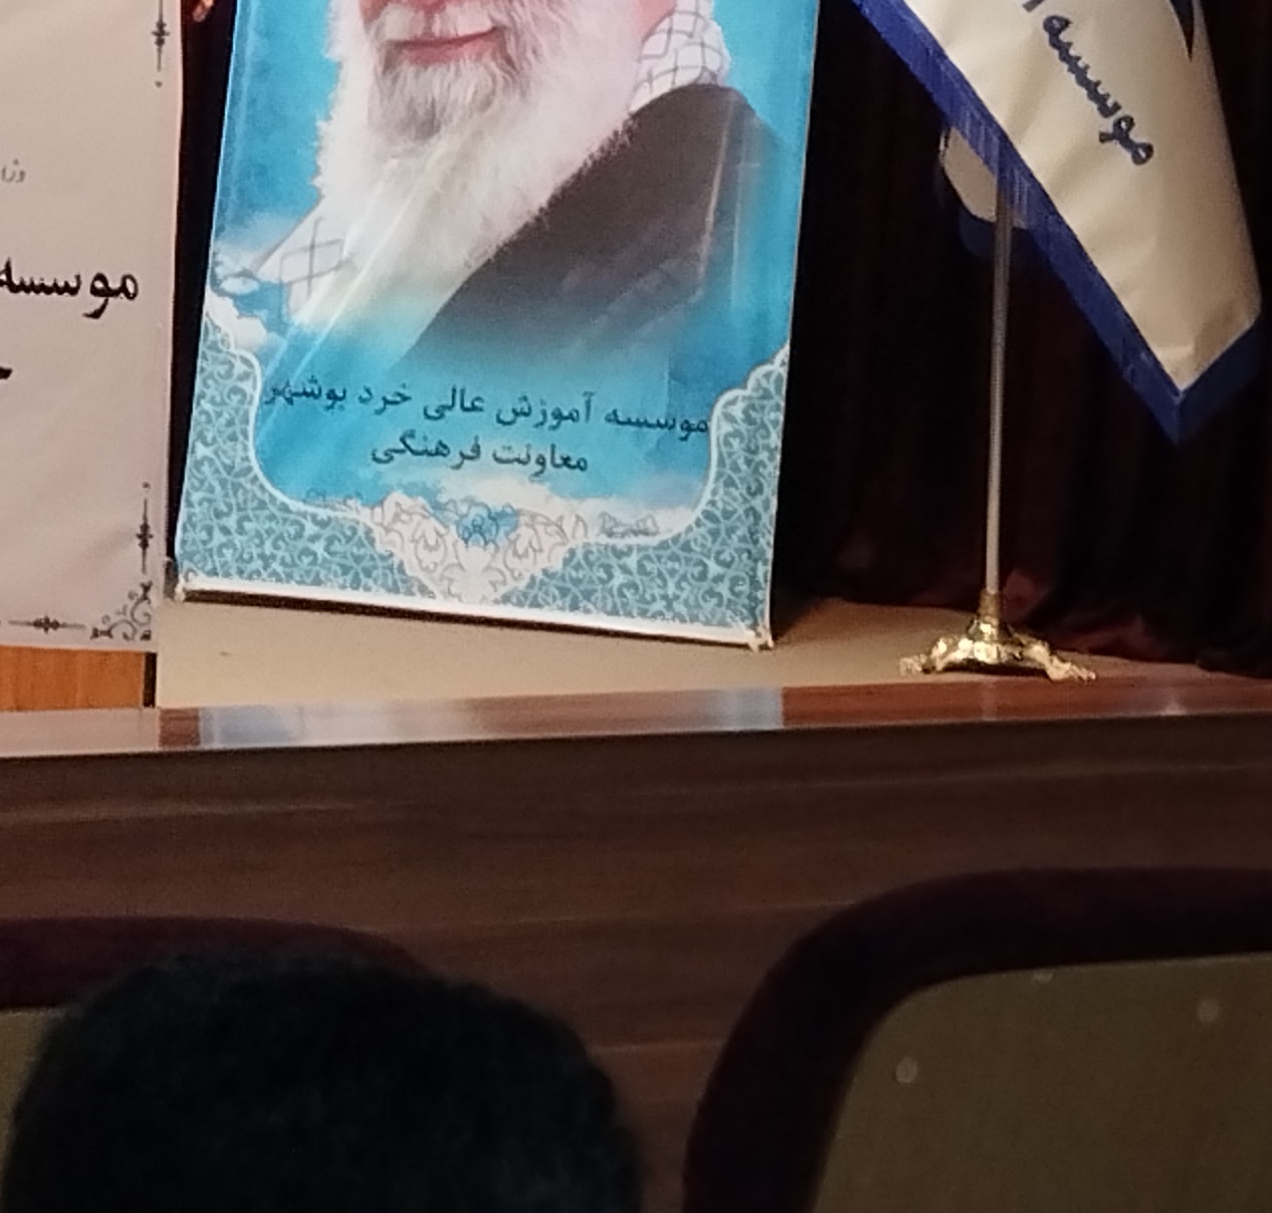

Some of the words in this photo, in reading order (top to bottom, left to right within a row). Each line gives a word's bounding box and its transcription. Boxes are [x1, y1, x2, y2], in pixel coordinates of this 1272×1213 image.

[1042, 14, 1154, 166] موسسه
[263, 374, 348, 412] بوشهر
[357, 381, 413, 416] خرد
[423, 383, 486, 422] عالی
[495, 390, 597, 431] آموزش
[603, 407, 709, 442] موسسه
[370, 428, 481, 471] فرهنگی
[491, 442, 590, 478] معاونت
